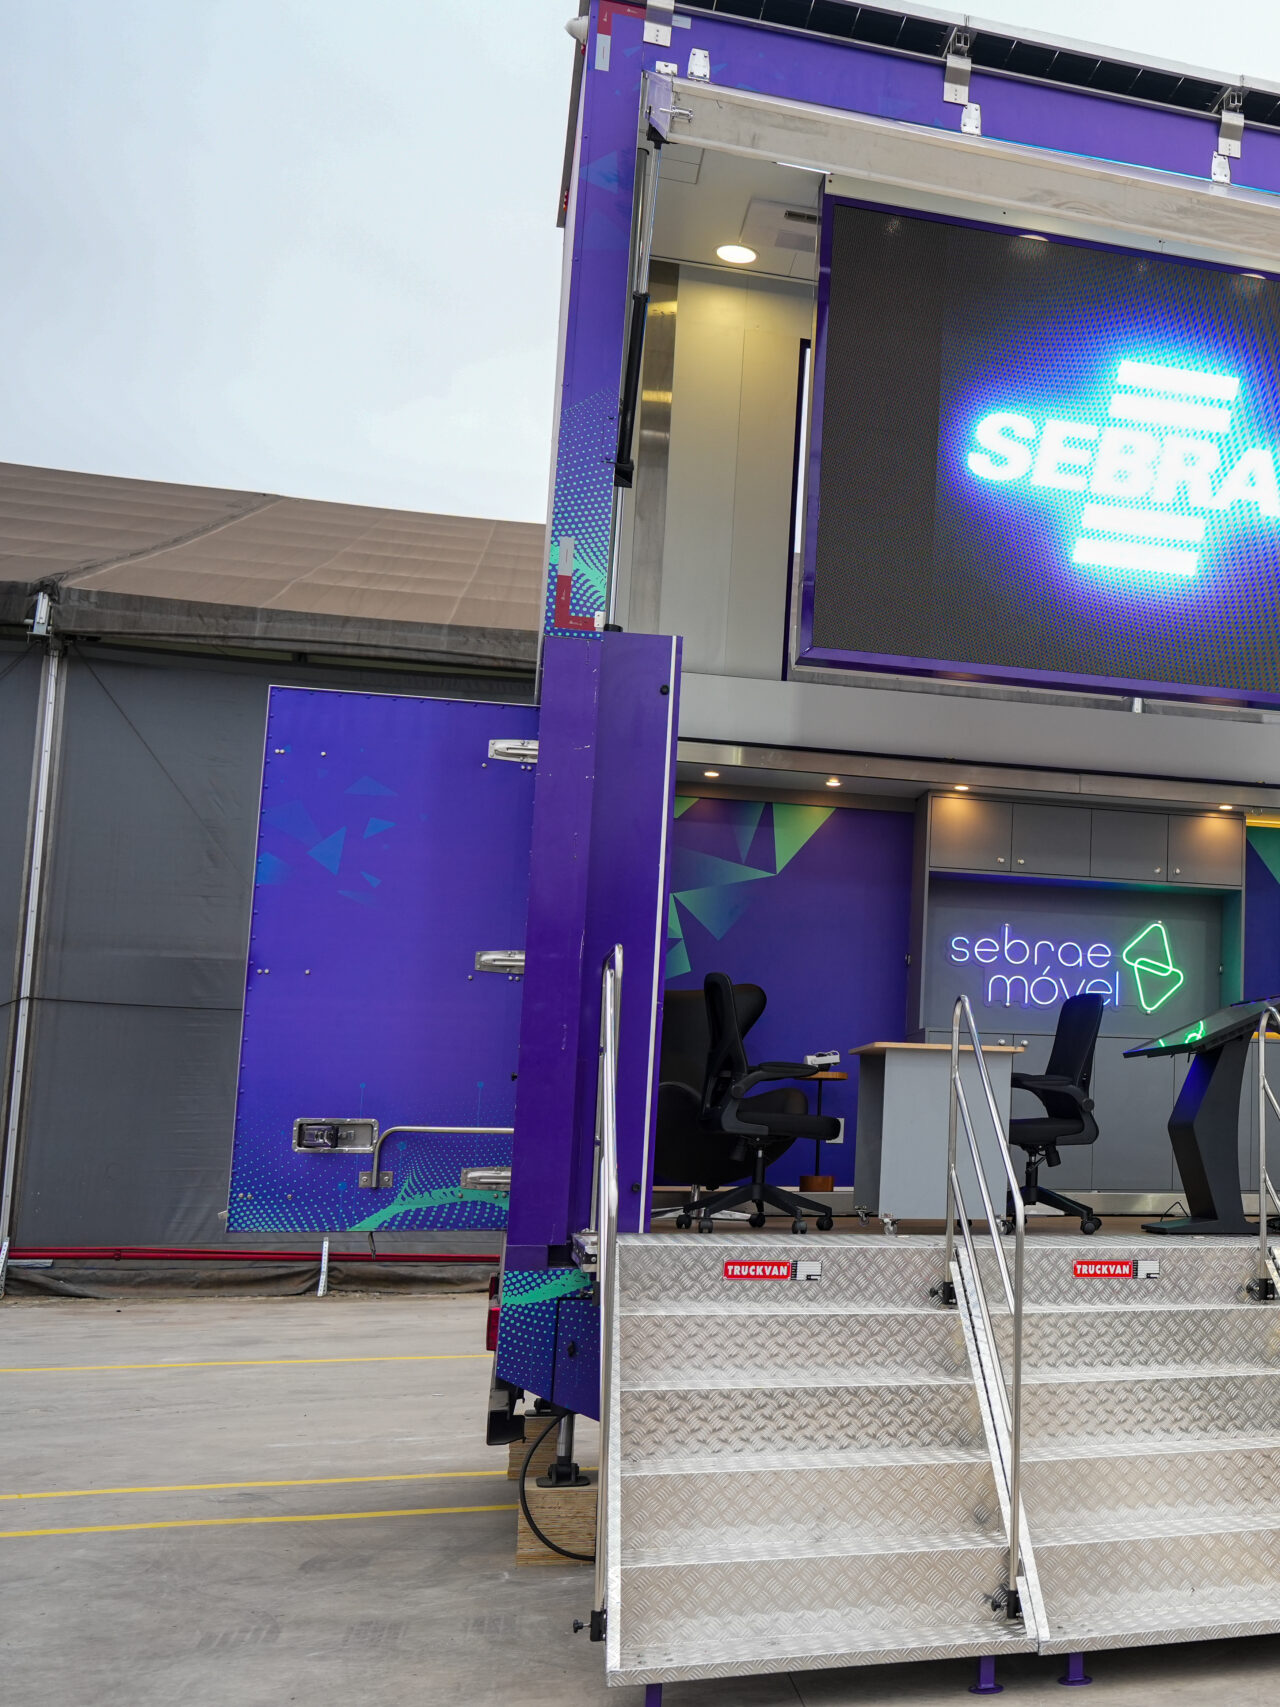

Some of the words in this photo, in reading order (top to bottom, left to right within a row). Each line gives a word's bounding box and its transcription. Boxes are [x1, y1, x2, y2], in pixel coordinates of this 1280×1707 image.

[951, 923, 1112, 969] sebrae
[988, 965, 1120, 1007] móvel
[727, 1265, 788, 1276] TRUCKVAN
[1076, 1264, 1130, 1275] TRUCKVAN
